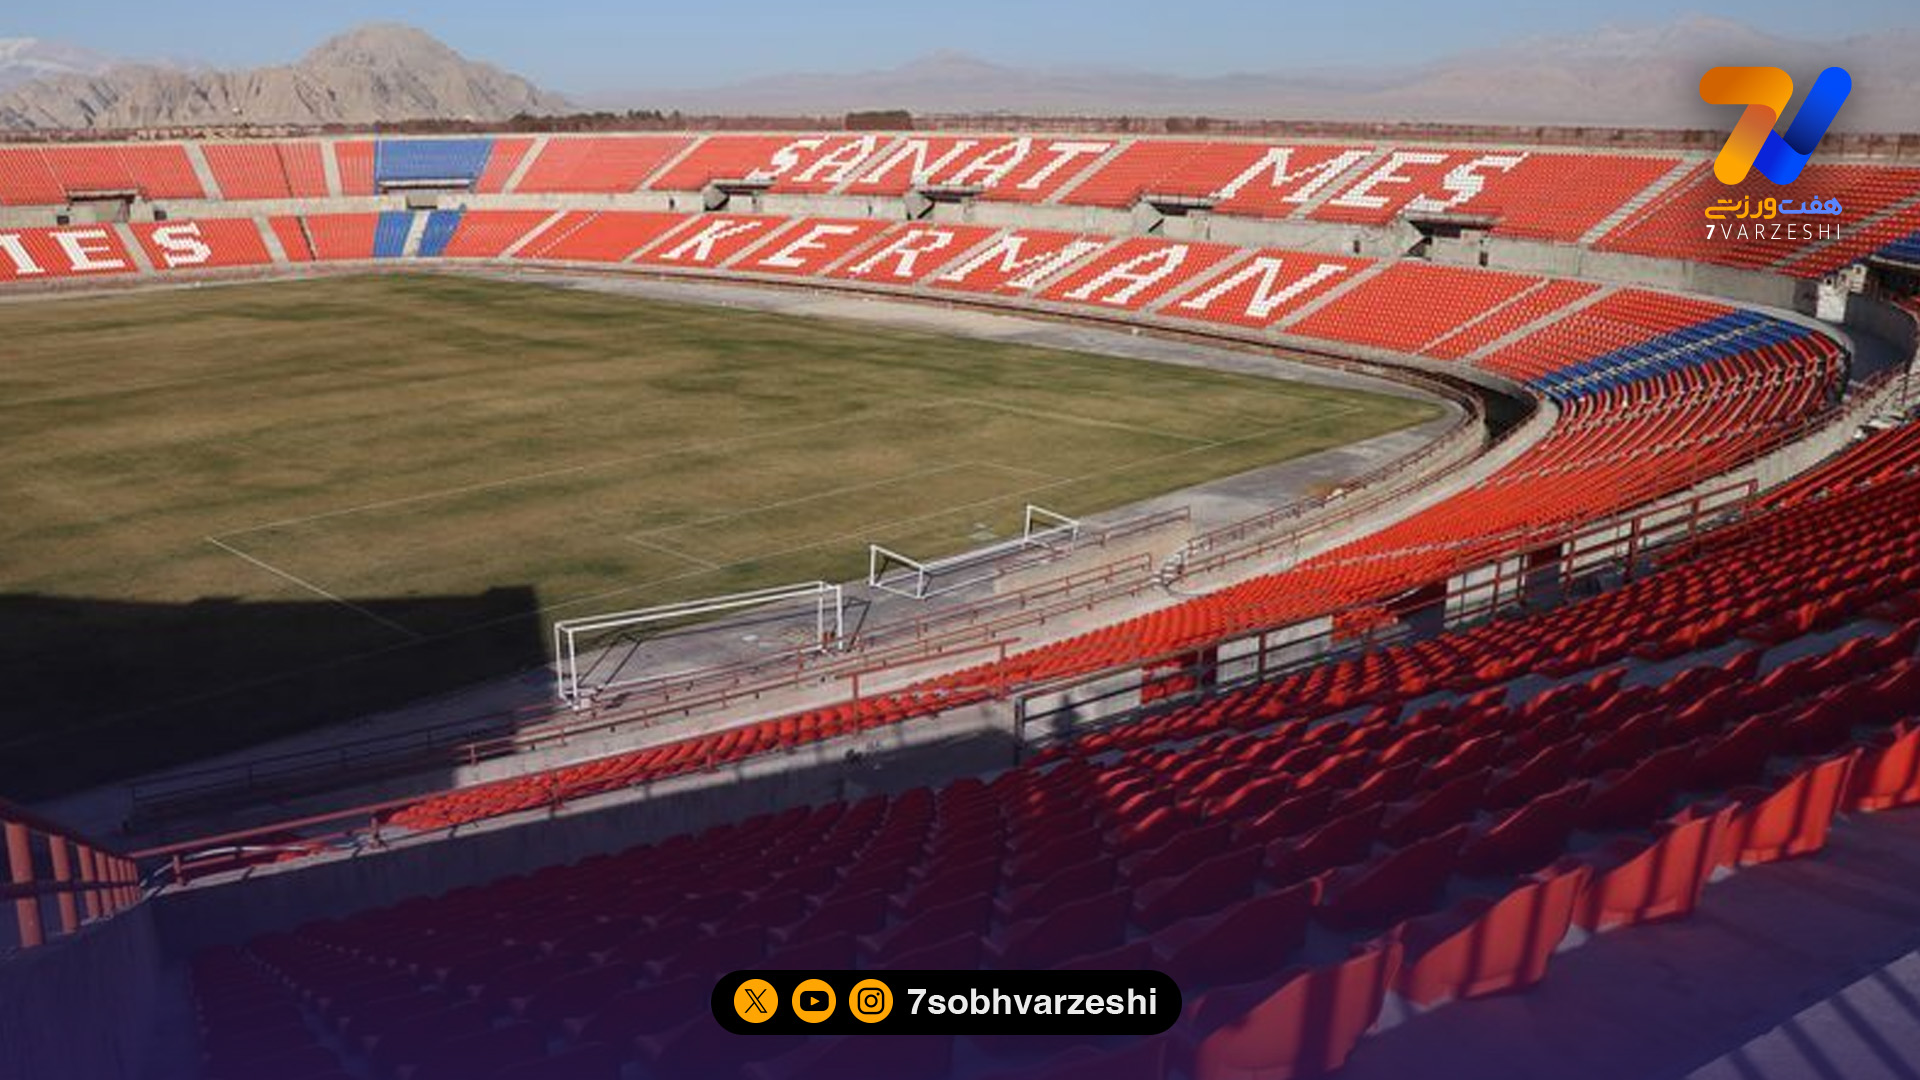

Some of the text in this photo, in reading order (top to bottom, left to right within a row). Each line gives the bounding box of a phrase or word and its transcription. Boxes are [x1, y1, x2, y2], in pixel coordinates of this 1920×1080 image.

[744, 134, 1528, 214] SANAT MES
[660, 219, 1347, 318] KERMAN
